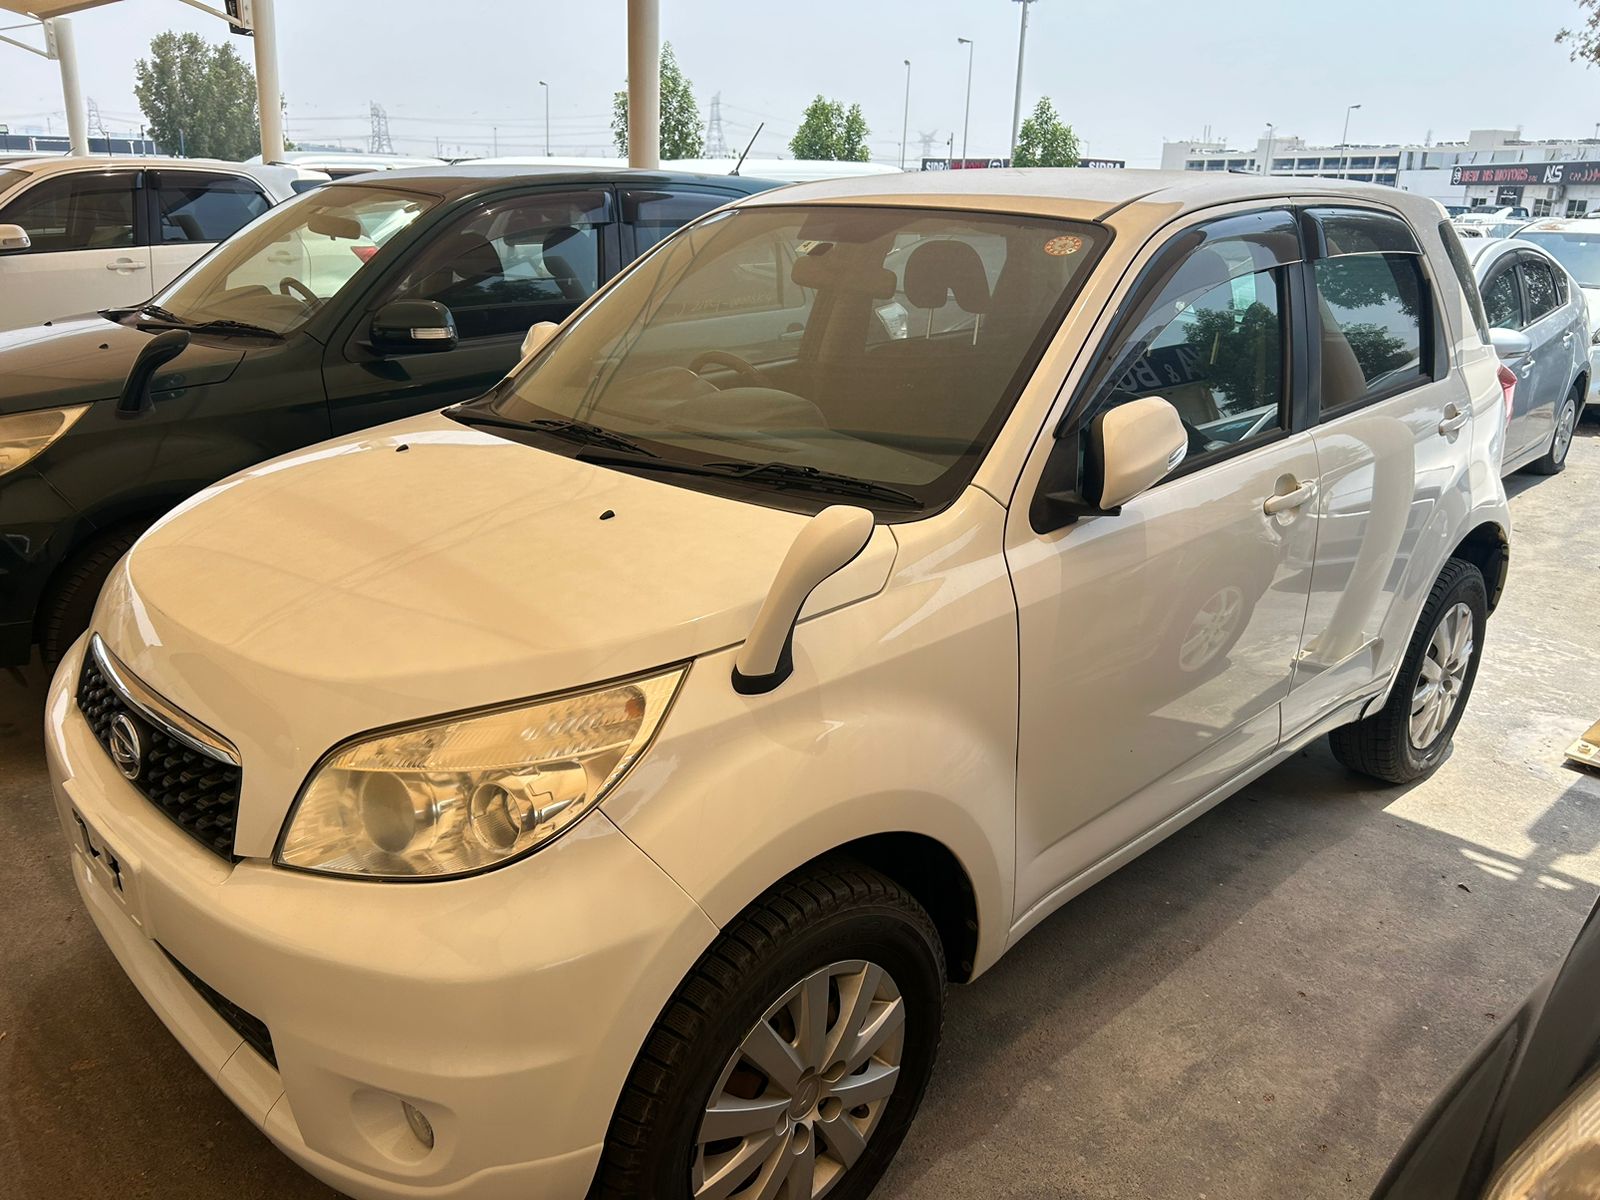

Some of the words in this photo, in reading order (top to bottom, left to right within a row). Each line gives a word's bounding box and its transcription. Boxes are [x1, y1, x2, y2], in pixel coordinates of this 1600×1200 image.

[1461, 170, 1480, 181] NEW
[1494, 168, 1529, 181] MOTORS
[1543, 165, 1563, 183] NS
